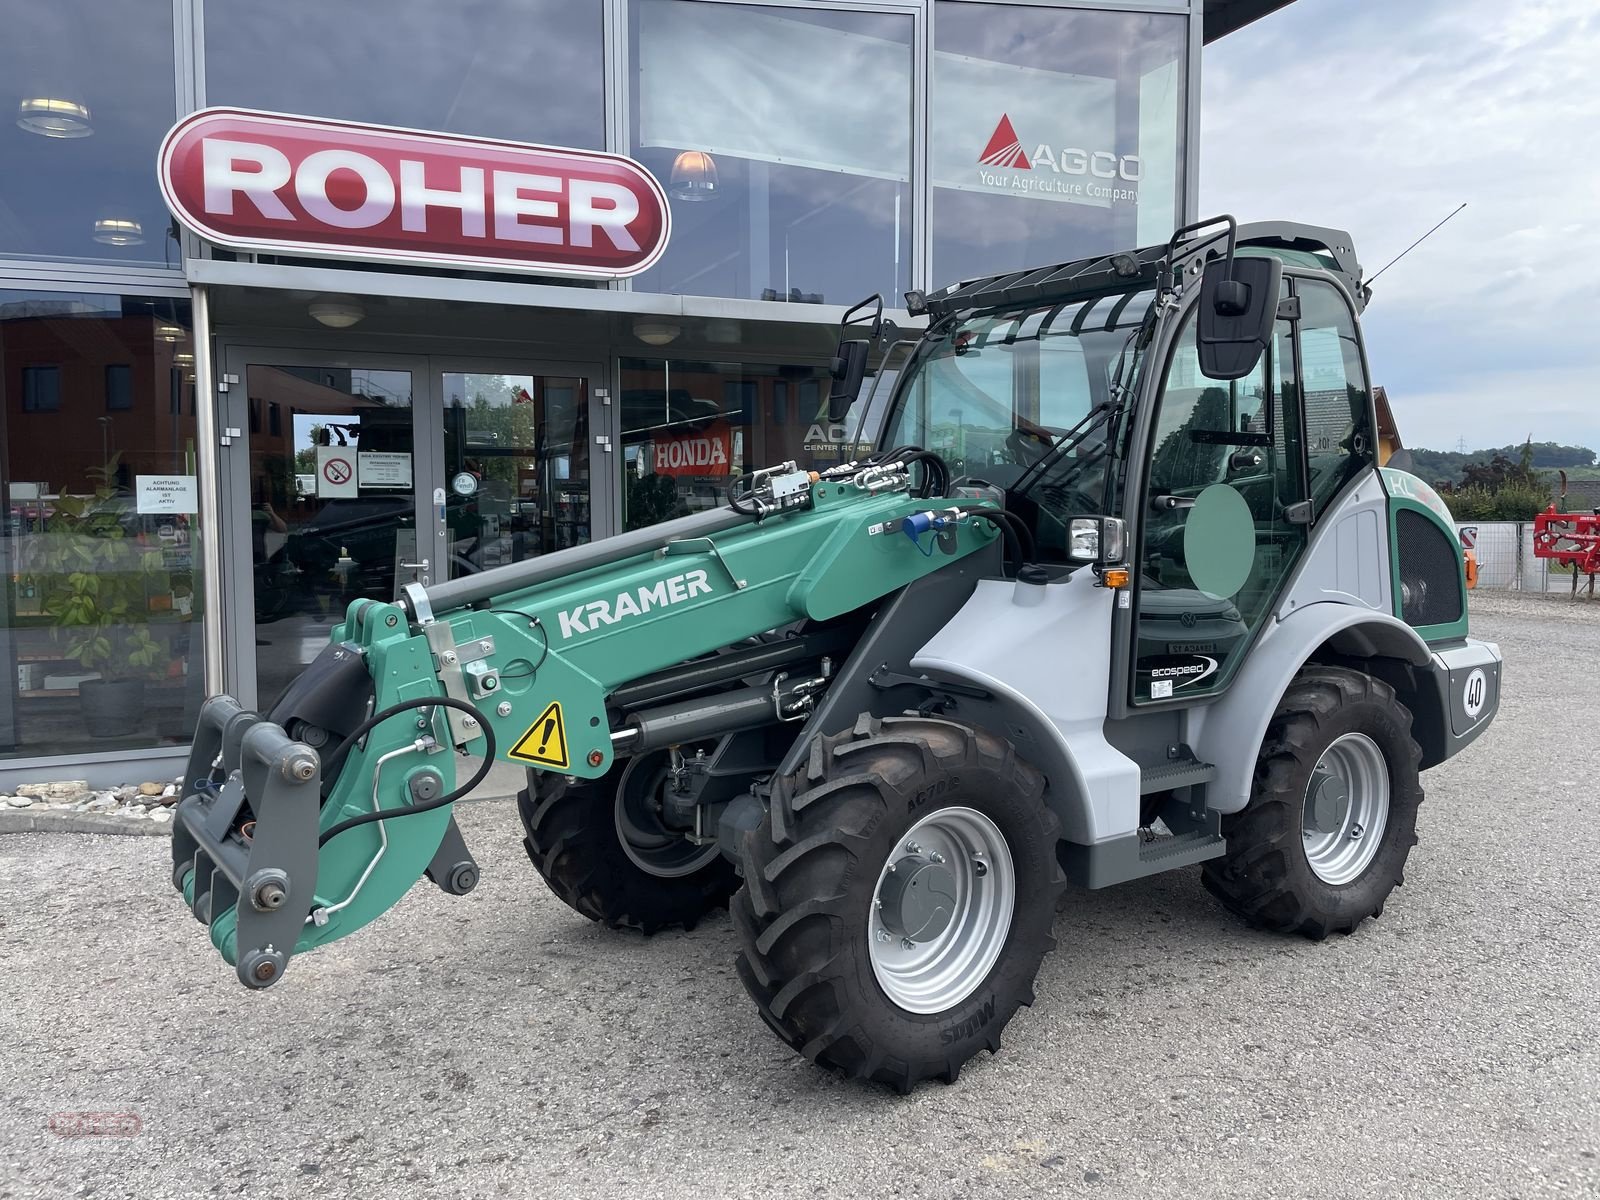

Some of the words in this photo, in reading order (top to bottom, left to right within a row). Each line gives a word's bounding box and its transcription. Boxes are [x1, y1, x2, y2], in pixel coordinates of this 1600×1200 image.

[1032, 144, 1144, 182] AGCO
[202, 138, 642, 252] ROHER
[980, 171, 1008, 188] Your
[1011, 175, 1082, 195] Agriculture
[1086, 182, 1139, 204] Company
[803, 424, 871, 443] ACA
[656, 437, 727, 468] HONDA
[558, 569, 713, 639] KRAMER
[1151, 663, 1204, 677] ecospeed
[1468, 677, 1482, 708] 40
